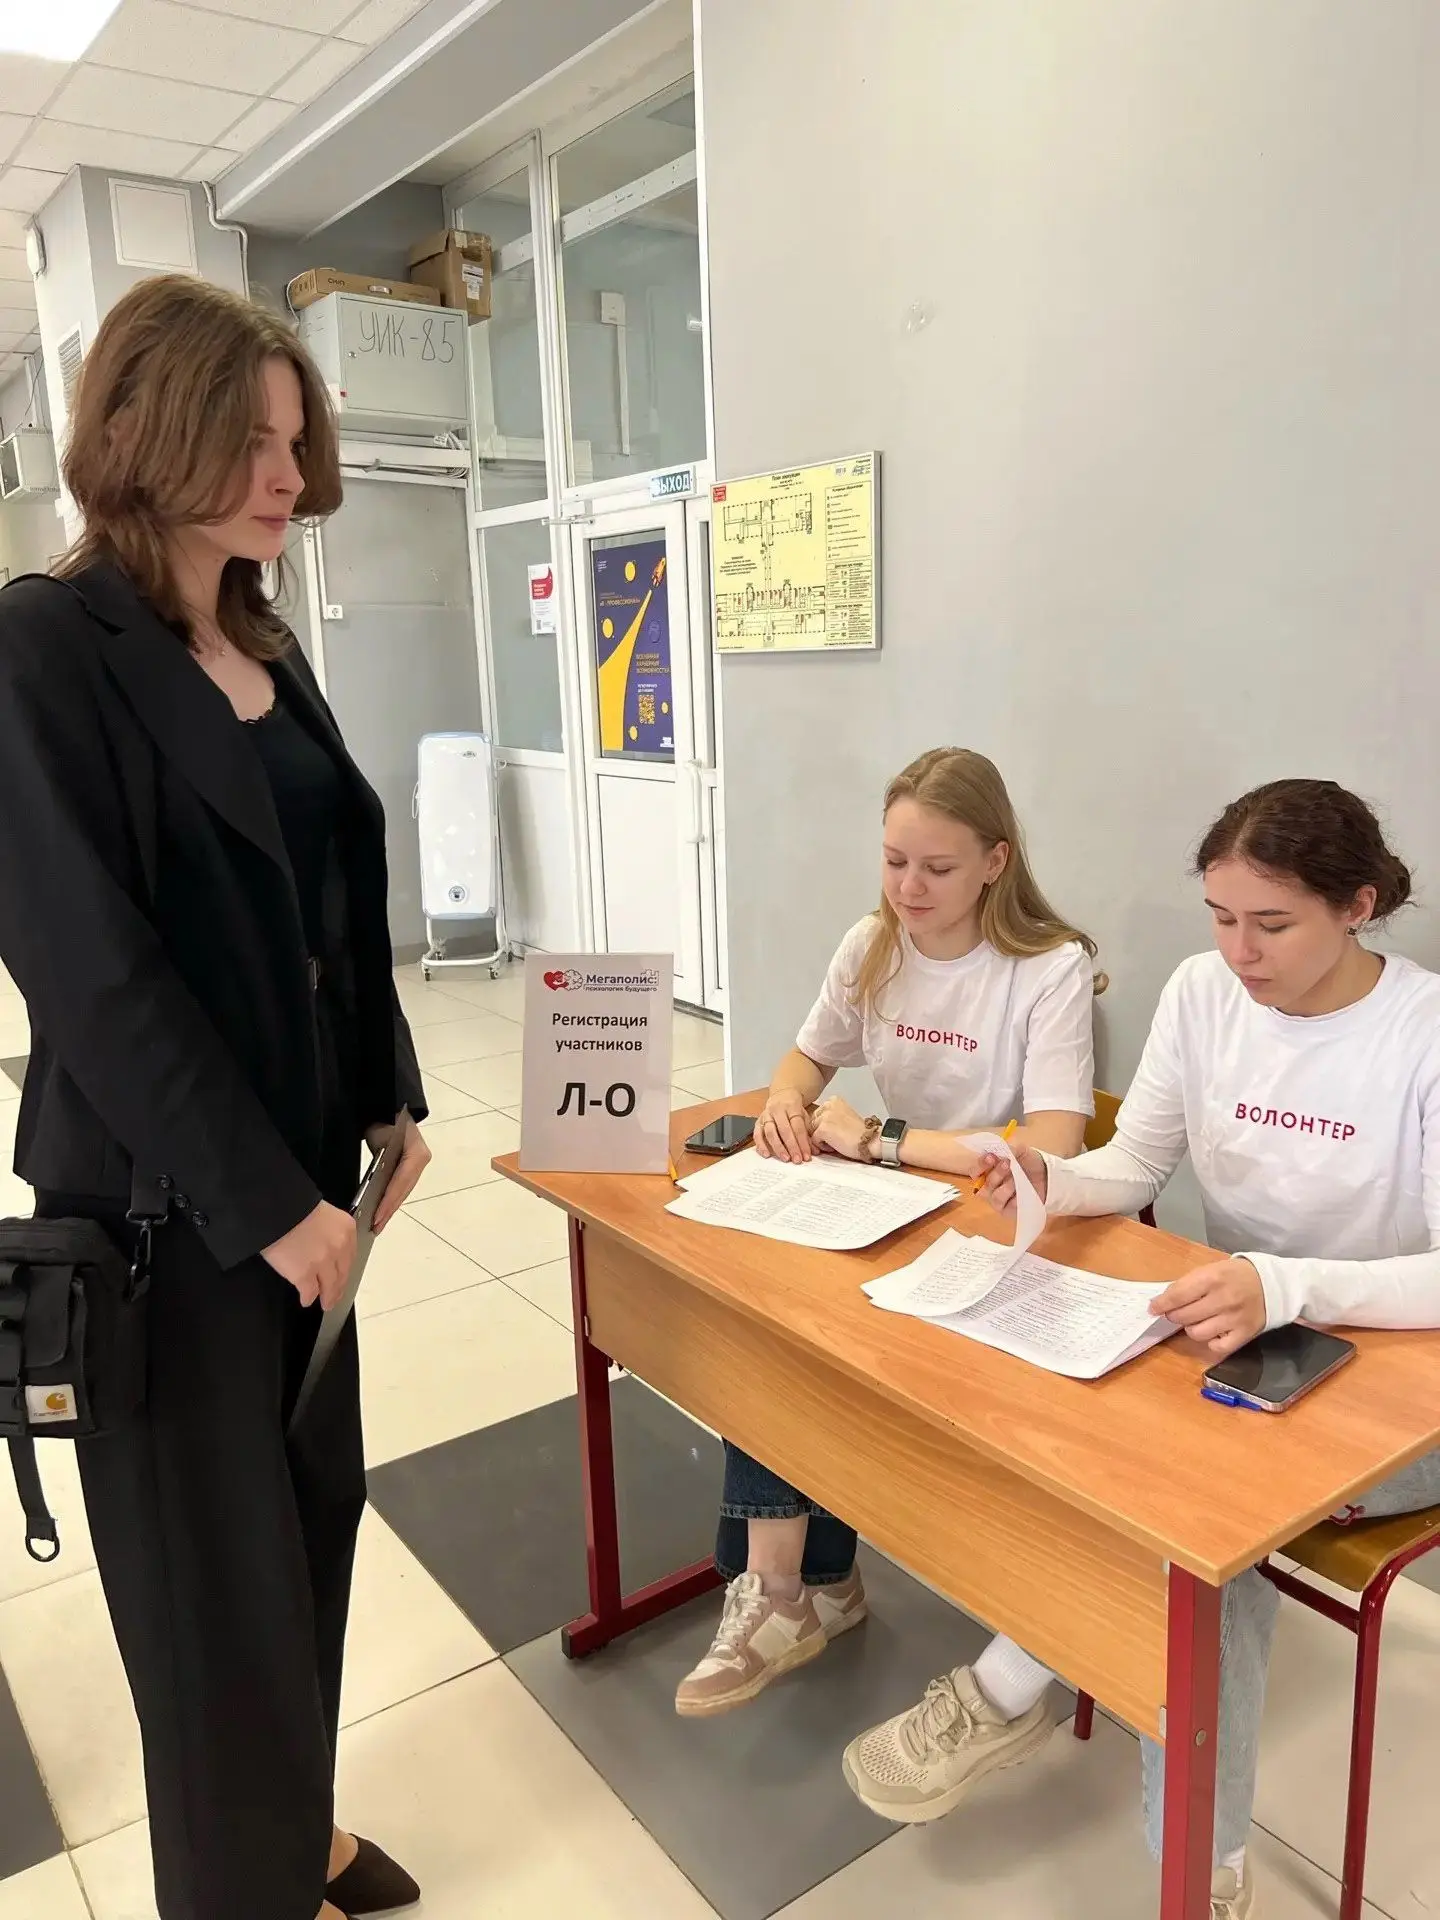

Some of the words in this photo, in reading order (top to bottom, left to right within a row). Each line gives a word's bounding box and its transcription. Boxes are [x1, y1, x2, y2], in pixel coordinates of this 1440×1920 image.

[358, 311, 456, 363] УИК-85
[625, 985, 658, 993] будущего
[552, 1013, 648, 1029] Регистрация
[555, 1039, 643, 1052] участников
[896, 1024, 978, 1053] ВОЛОНТЕР
[556, 1082, 636, 1118] Л-О
[1235, 1102, 1356, 1141] ВОЛОНТЕР
